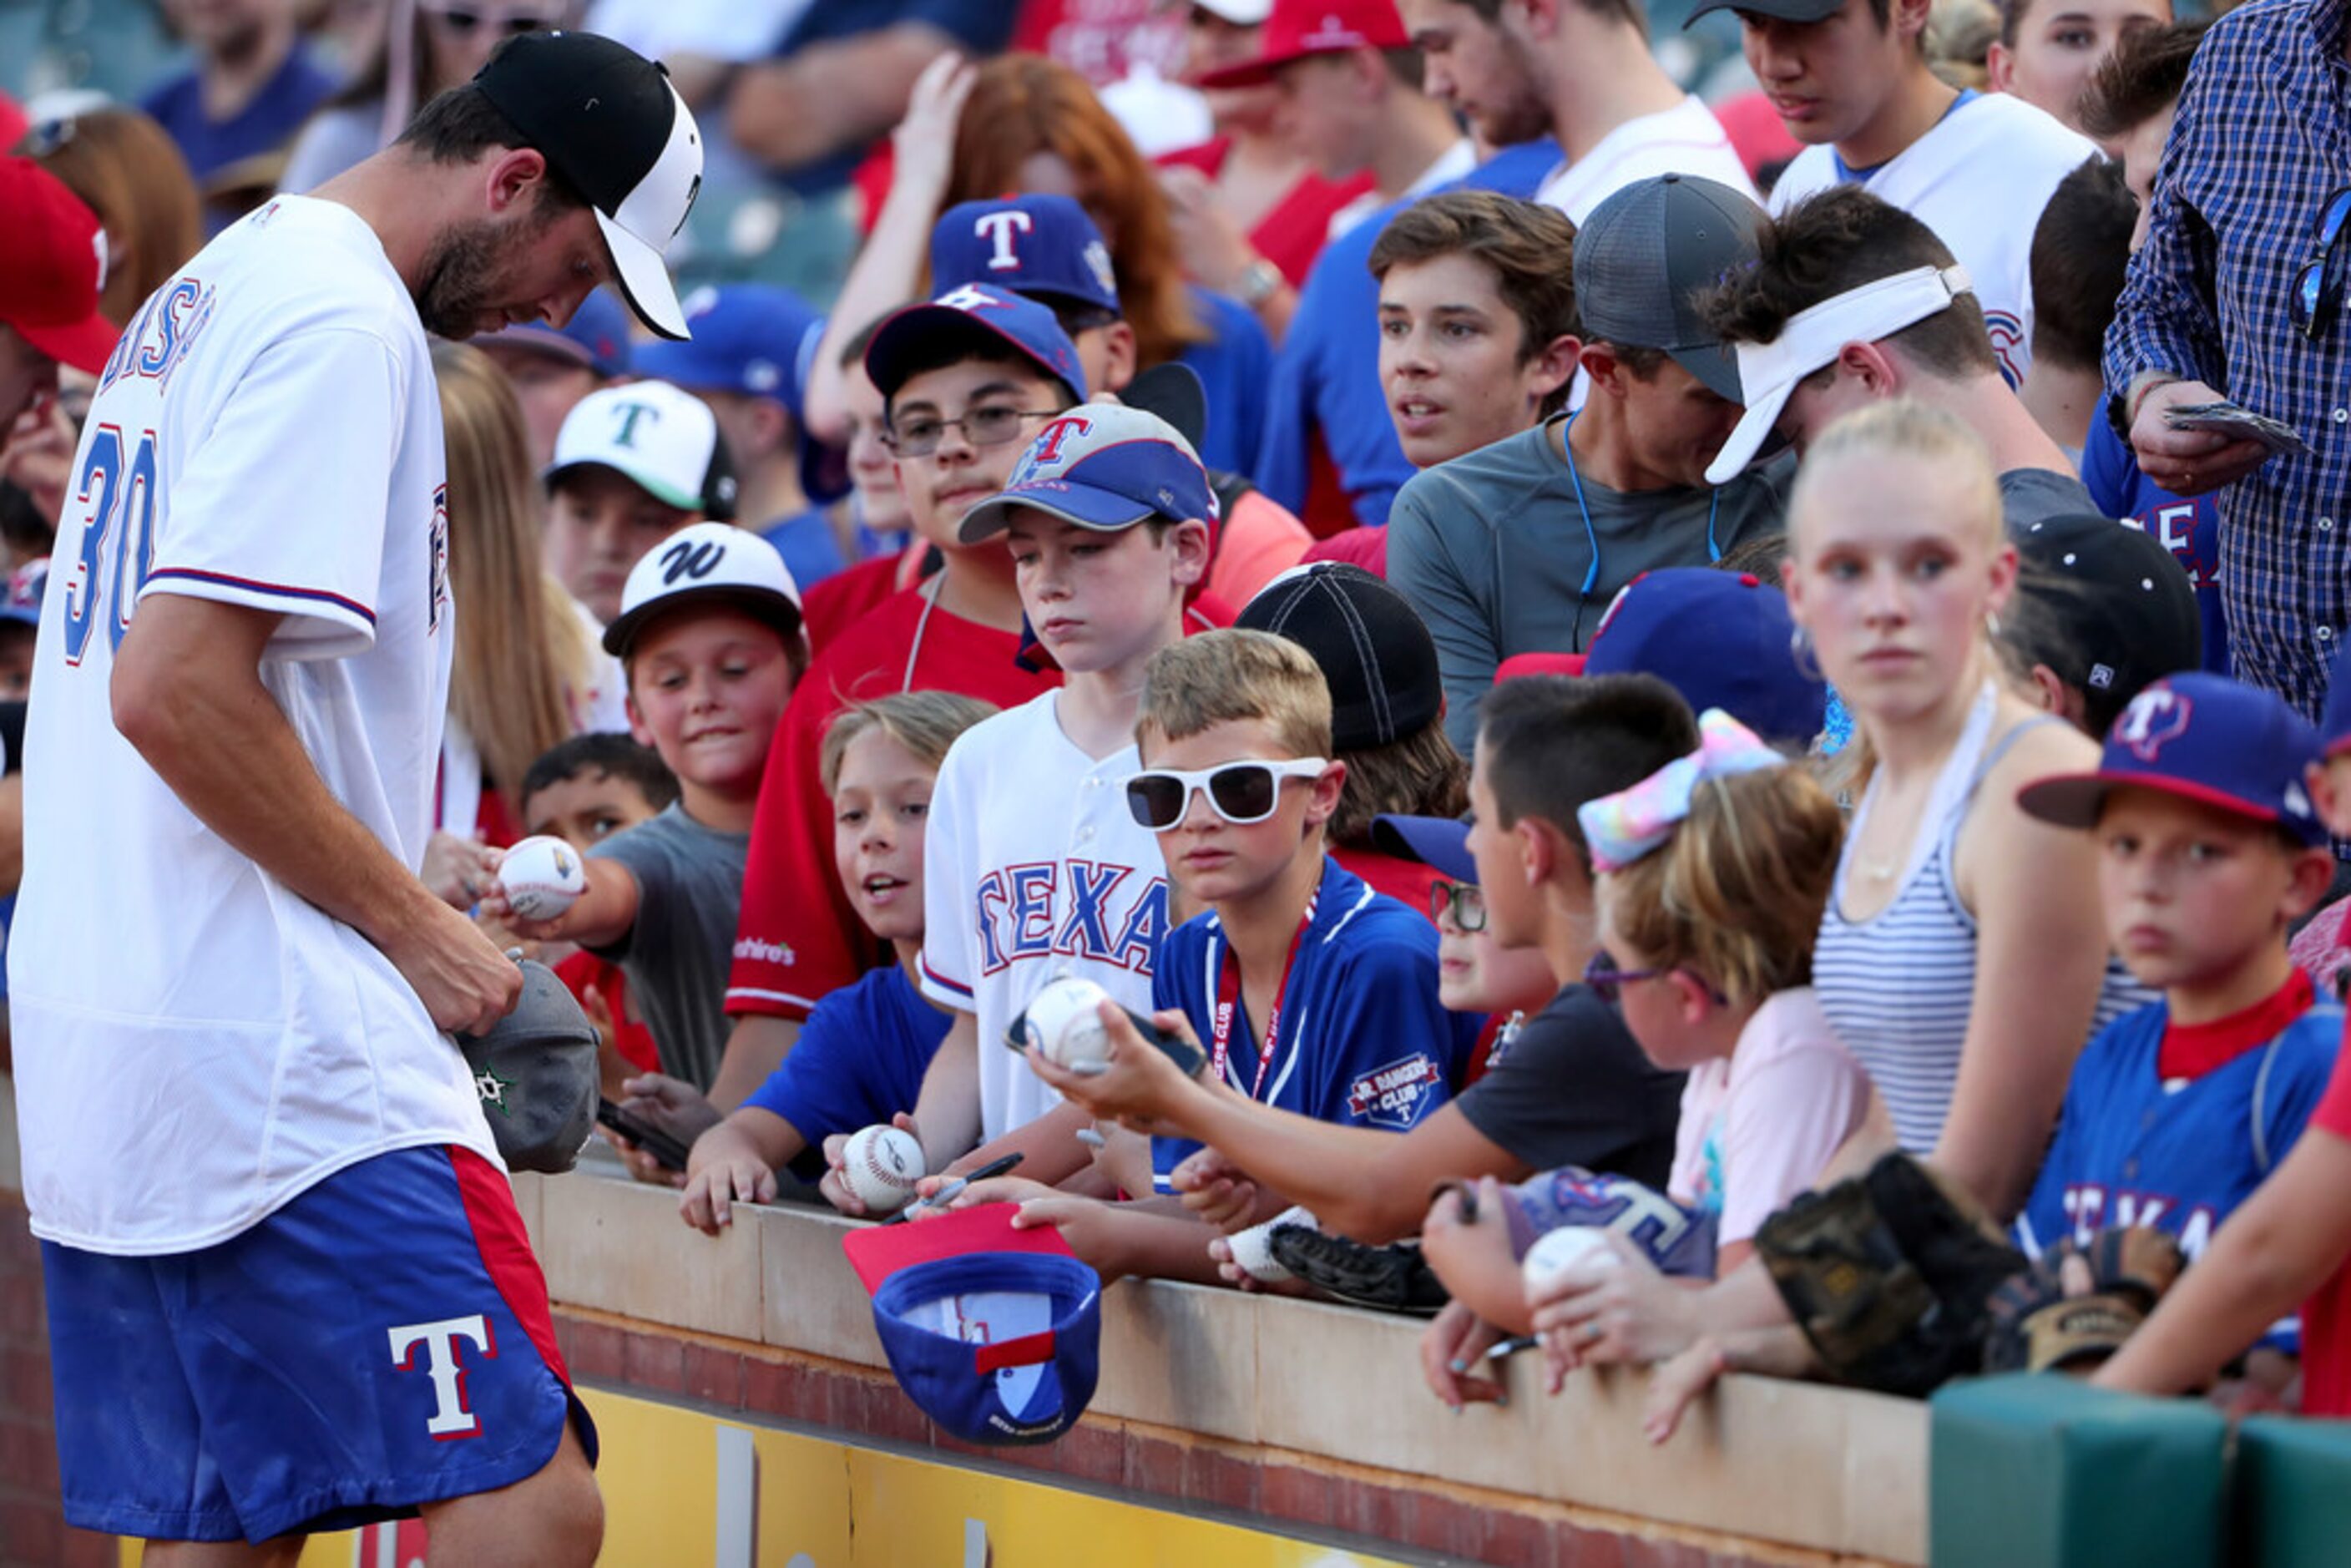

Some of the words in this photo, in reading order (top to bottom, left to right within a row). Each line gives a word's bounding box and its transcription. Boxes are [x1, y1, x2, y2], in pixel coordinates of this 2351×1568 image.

[975, 210, 1035, 272] T
[610, 403, 660, 448] T
[1034, 417, 1094, 465] T
[63, 422, 158, 668] 30
[659, 541, 726, 586] W
[2123, 689, 2176, 742] T
[1380, 1083, 1418, 1111] CLUB
[387, 1313, 498, 1444] T
